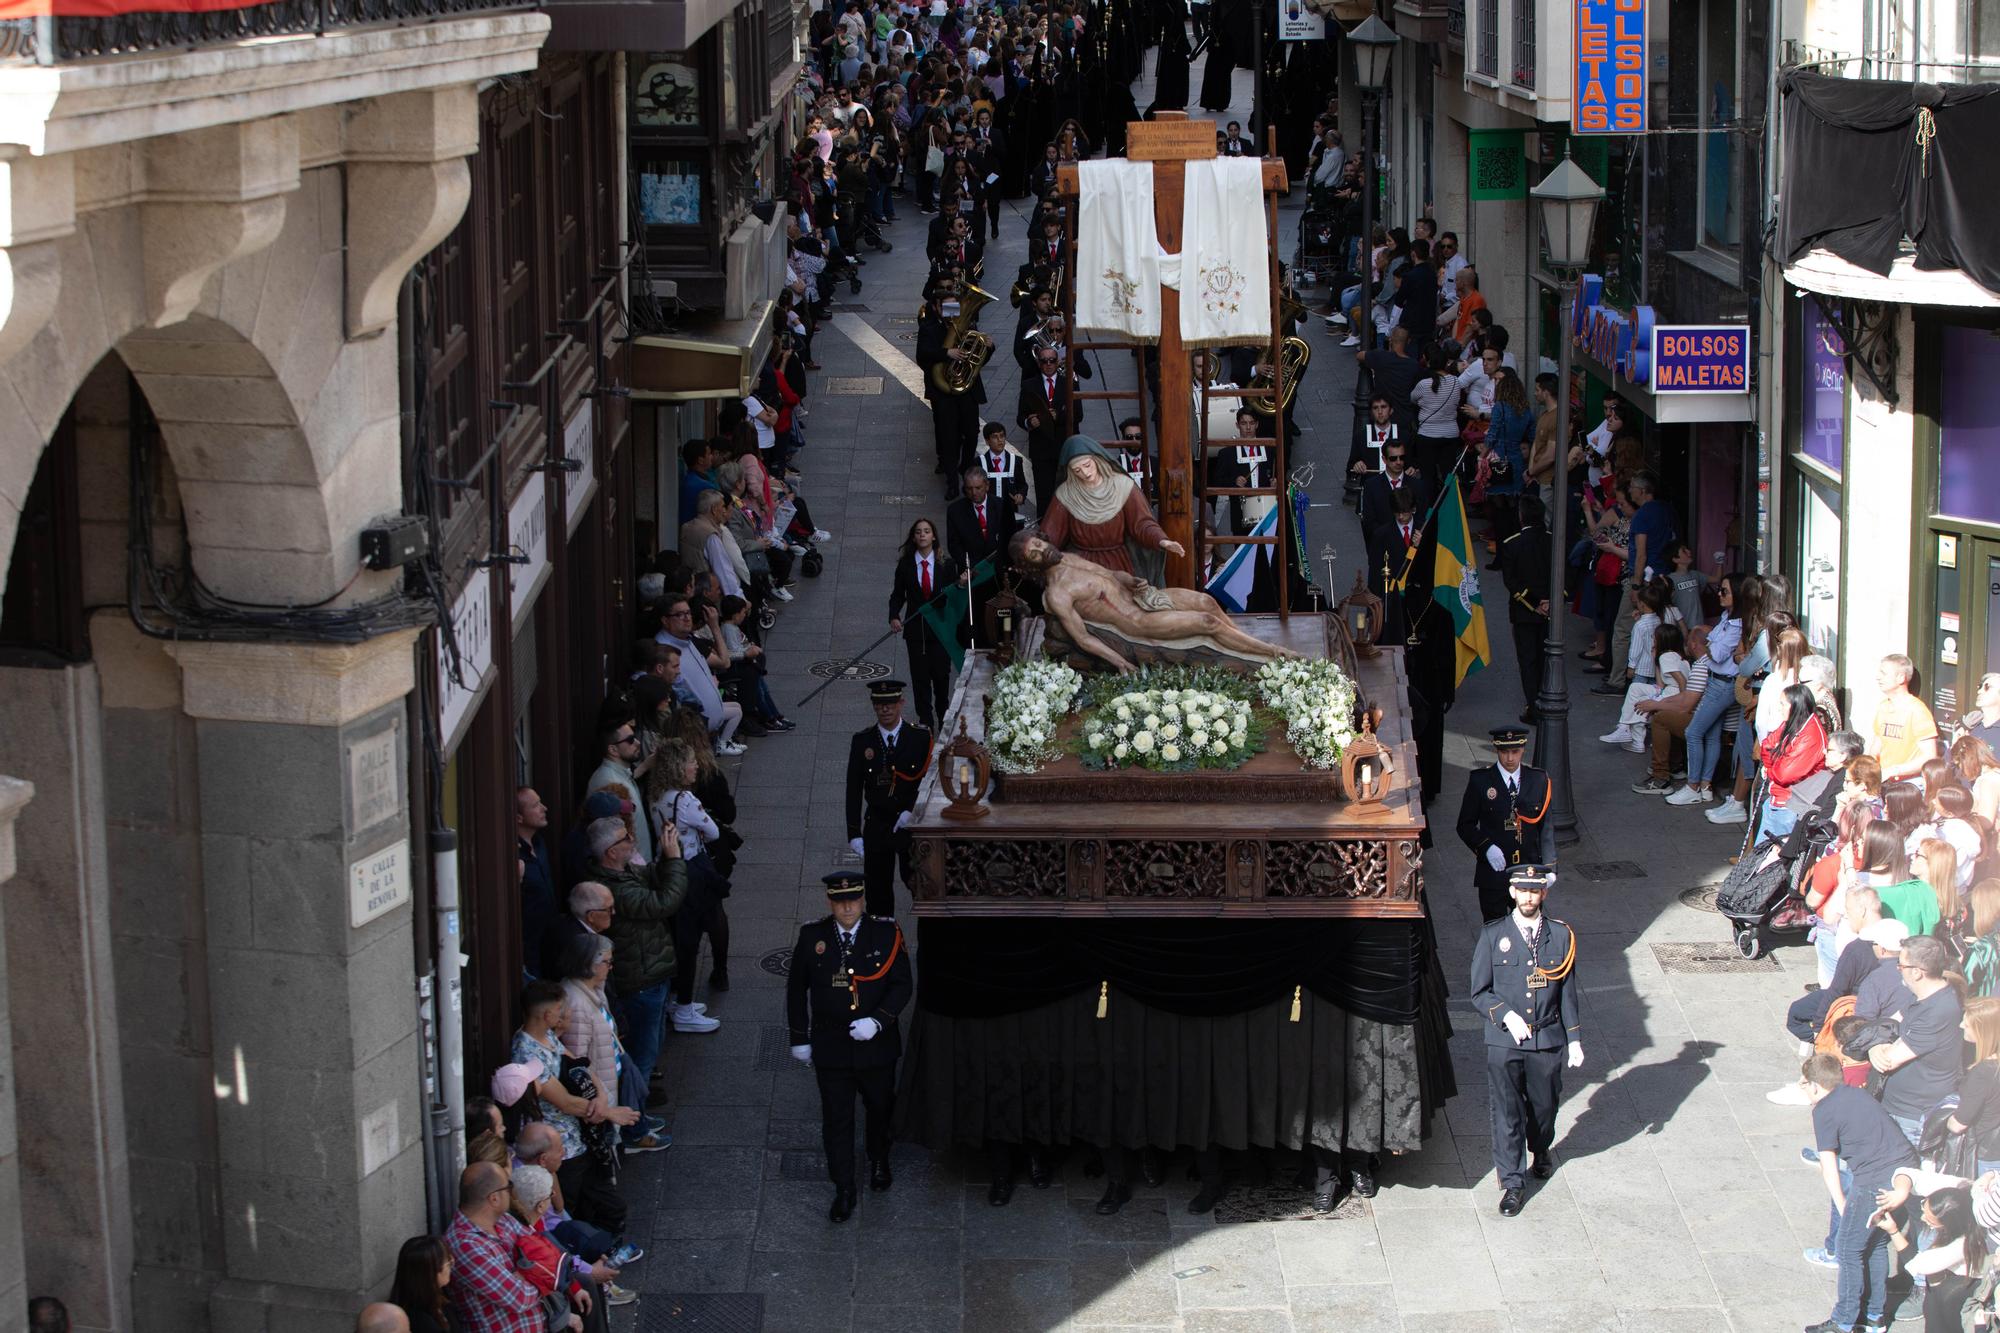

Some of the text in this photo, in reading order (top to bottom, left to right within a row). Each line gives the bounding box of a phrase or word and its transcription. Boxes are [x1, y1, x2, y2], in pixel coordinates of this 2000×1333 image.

[1581, 0, 1607, 129] LETAS
[1663, 335, 1739, 356] BOLSOS
[1658, 365, 1744, 385] MALETAS
[371, 854, 397, 876] CALLE
[369, 872, 394, 894] DE LA
[367, 888, 397, 912] RENOVA
